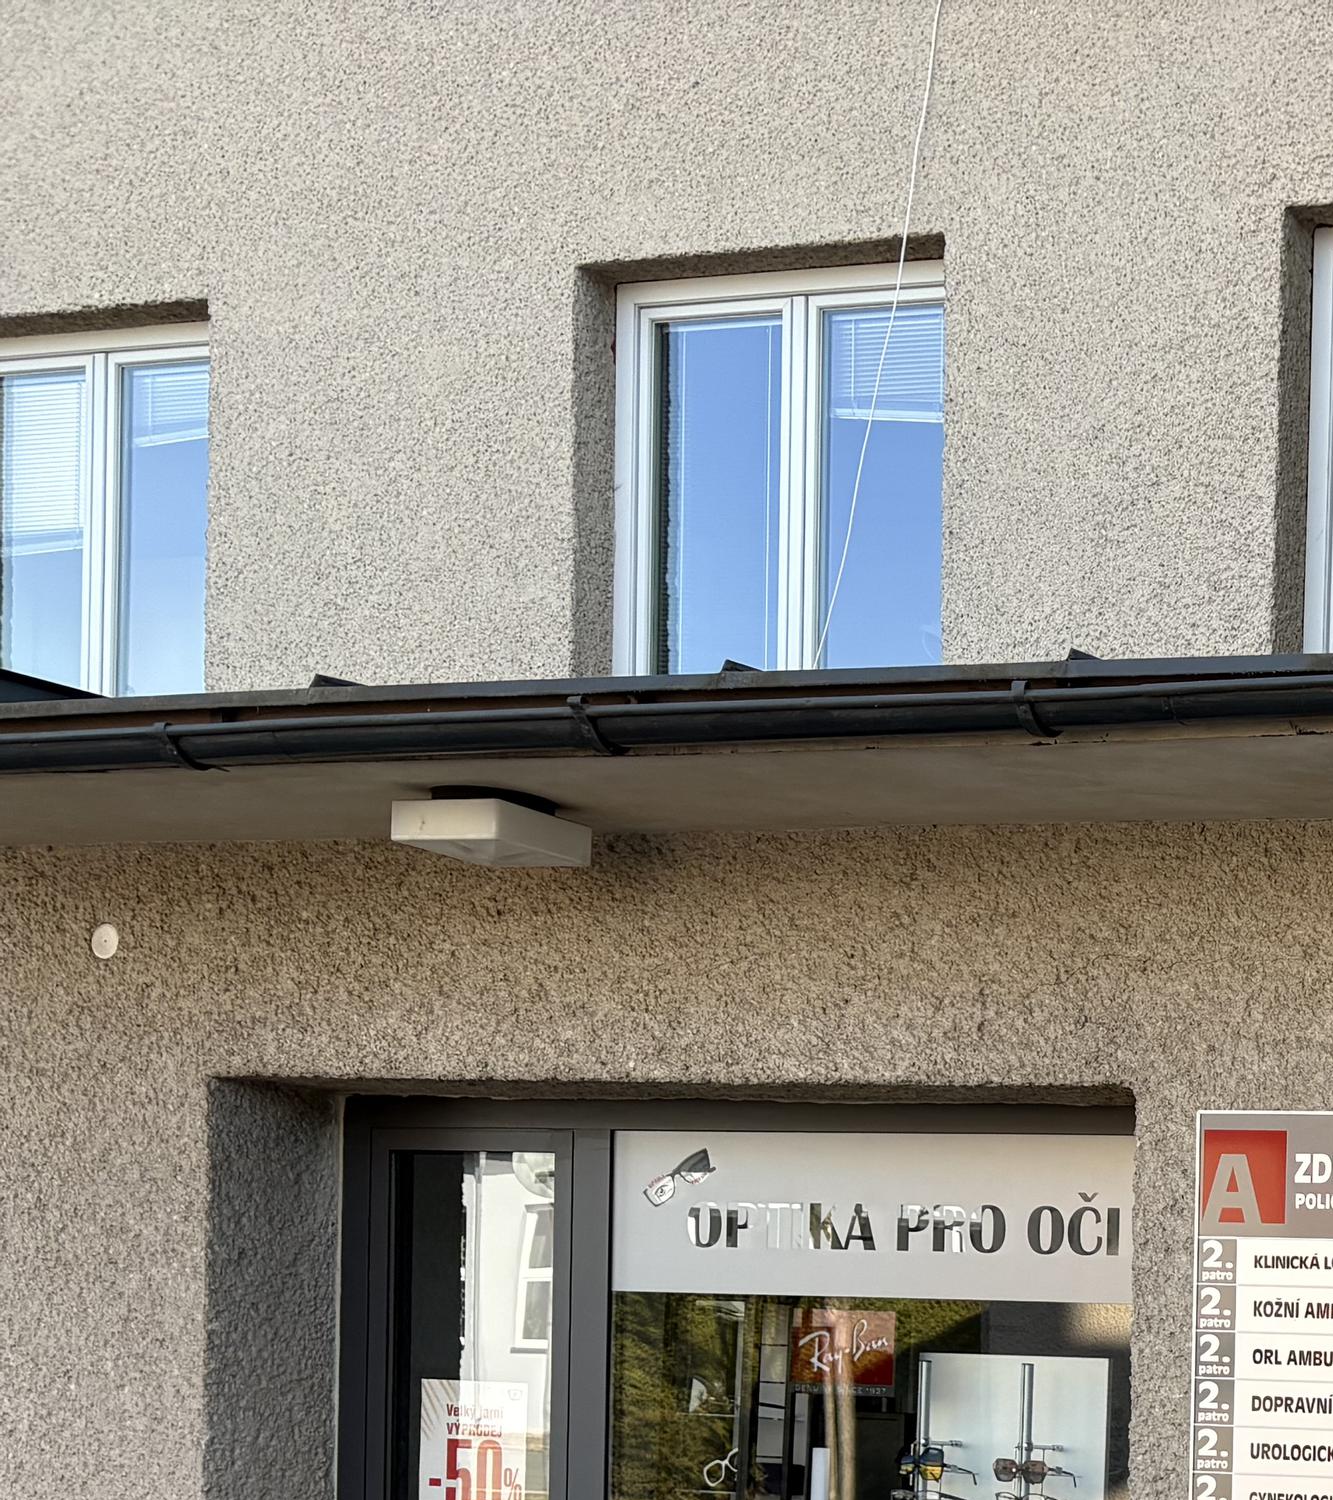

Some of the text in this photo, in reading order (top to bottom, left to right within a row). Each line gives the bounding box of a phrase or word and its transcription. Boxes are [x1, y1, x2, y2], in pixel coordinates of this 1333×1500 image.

[1201, 1154, 1262, 1223] A
[687, 1192, 1120, 1256] OPTIKA PRO OČI
[1202, 1240, 1233, 1268] 2.
[1254, 1253, 1320, 1270] KLINICKÁ
[1202, 1270, 1233, 1282] patro
[1200, 1287, 1231, 1315] 2.
[1253, 1298, 1300, 1318] KOŽNÍ
[1200, 1317, 1231, 1328] patro
[799, 1320, 888, 1374] Ray-Ban
[1200, 1334, 1230, 1362] 2.
[1252, 1349, 1282, 1365] ORL
[1198, 1364, 1230, 1375] patro
[1198, 1381, 1230, 1410] 2.
[1251, 1394, 1333, 1414] DOPRAVNÍ
[446, 1404, 476, 1419] Velký
[1198, 1411, 1229, 1422] patro
[446, 1420, 502, 1438] VÝPRODEJ
[1197, 1428, 1228, 1458] 2.
[1196, 1458, 1228, 1470] patro
